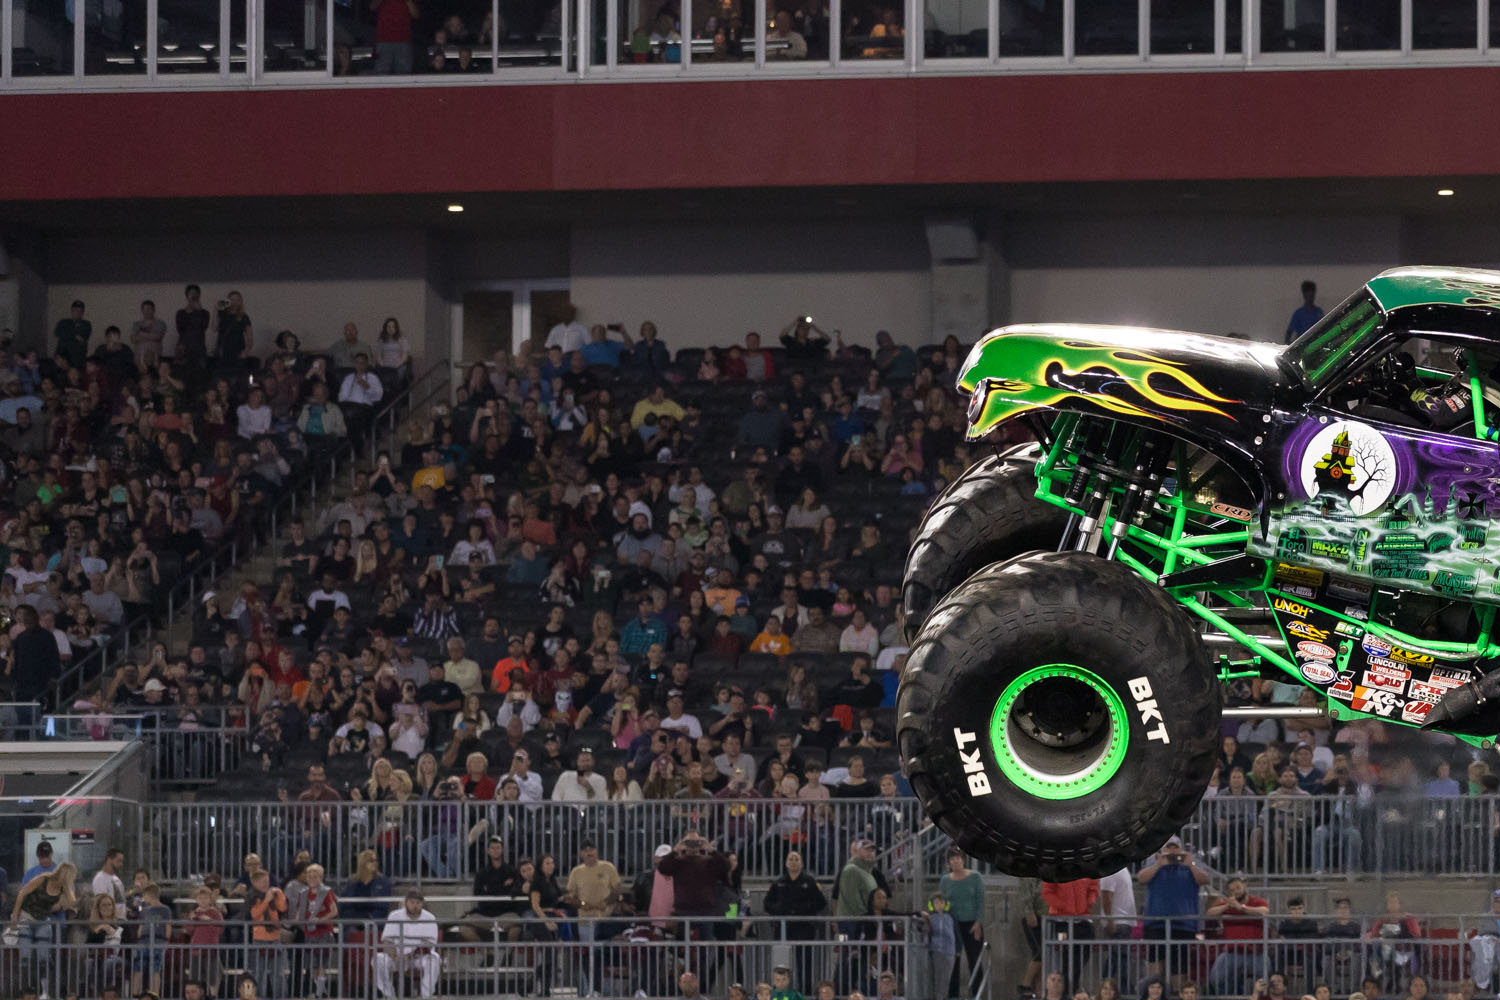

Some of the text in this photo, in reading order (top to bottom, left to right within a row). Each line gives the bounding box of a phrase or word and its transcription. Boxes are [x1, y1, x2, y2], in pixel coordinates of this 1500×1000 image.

[1274, 599, 1309, 617] UNOH
[1335, 622, 1363, 637] BKT
[1370, 656, 1405, 671] LINCOLN
[1375, 665, 1407, 678] WELDERS
[1304, 665, 1332, 679] TOTAL SEAL
[1127, 676, 1171, 745] BKT
[1360, 688, 1405, 717] K&N
[953, 727, 993, 798] BKT
